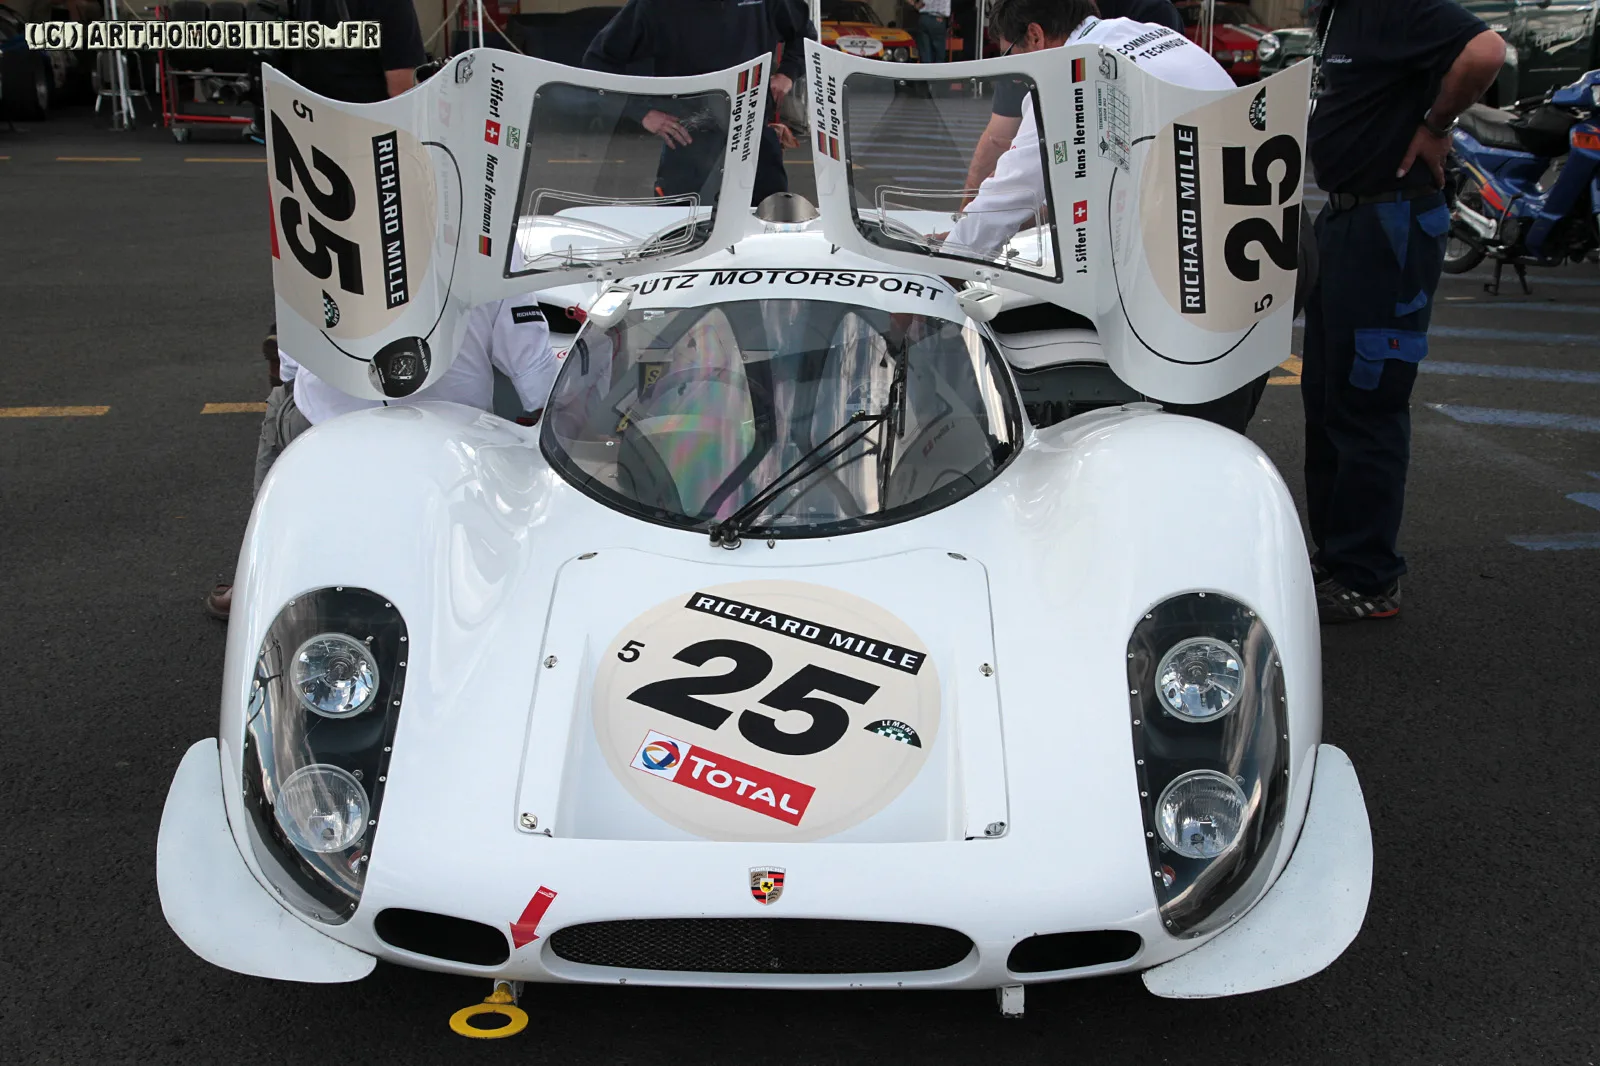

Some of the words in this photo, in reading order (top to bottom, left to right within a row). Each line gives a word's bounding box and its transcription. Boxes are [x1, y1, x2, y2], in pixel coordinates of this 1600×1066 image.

[1139, 37, 1188, 59] TECHNIQUE
[489, 77, 504, 118] Siffert
[827, 75, 837, 104] Pütz
[292, 99, 314, 123] 5
[732, 94, 746, 122] Ingo
[828, 108, 840, 136] Ingo
[1073, 88, 1086, 145] Hermann
[730, 124, 743, 152] Pütz
[485, 153, 498, 183] Hans
[1074, 149, 1087, 179] Hans
[1178, 129, 1196, 200] MILLE
[270, 109, 364, 295] 25
[378, 138, 400, 235] RICHARD
[482, 184, 496, 234] Hermann
[1221, 134, 1301, 282] 25
[1074, 227, 1087, 262] Siffert
[1182, 209, 1201, 308] RICHARD
[387, 241, 405, 304] MILLE
[709, 270, 945, 301] MOTORSPORT
[1254, 293, 1273, 313] 5
[695, 595, 820, 640] RICHARD
[829, 631, 918, 670] MILLE
[616, 639, 646, 664] 5
[626, 638, 881, 756] 25
[891, 720, 915, 736] MANS
[689, 753, 799, 816] TOTAL
